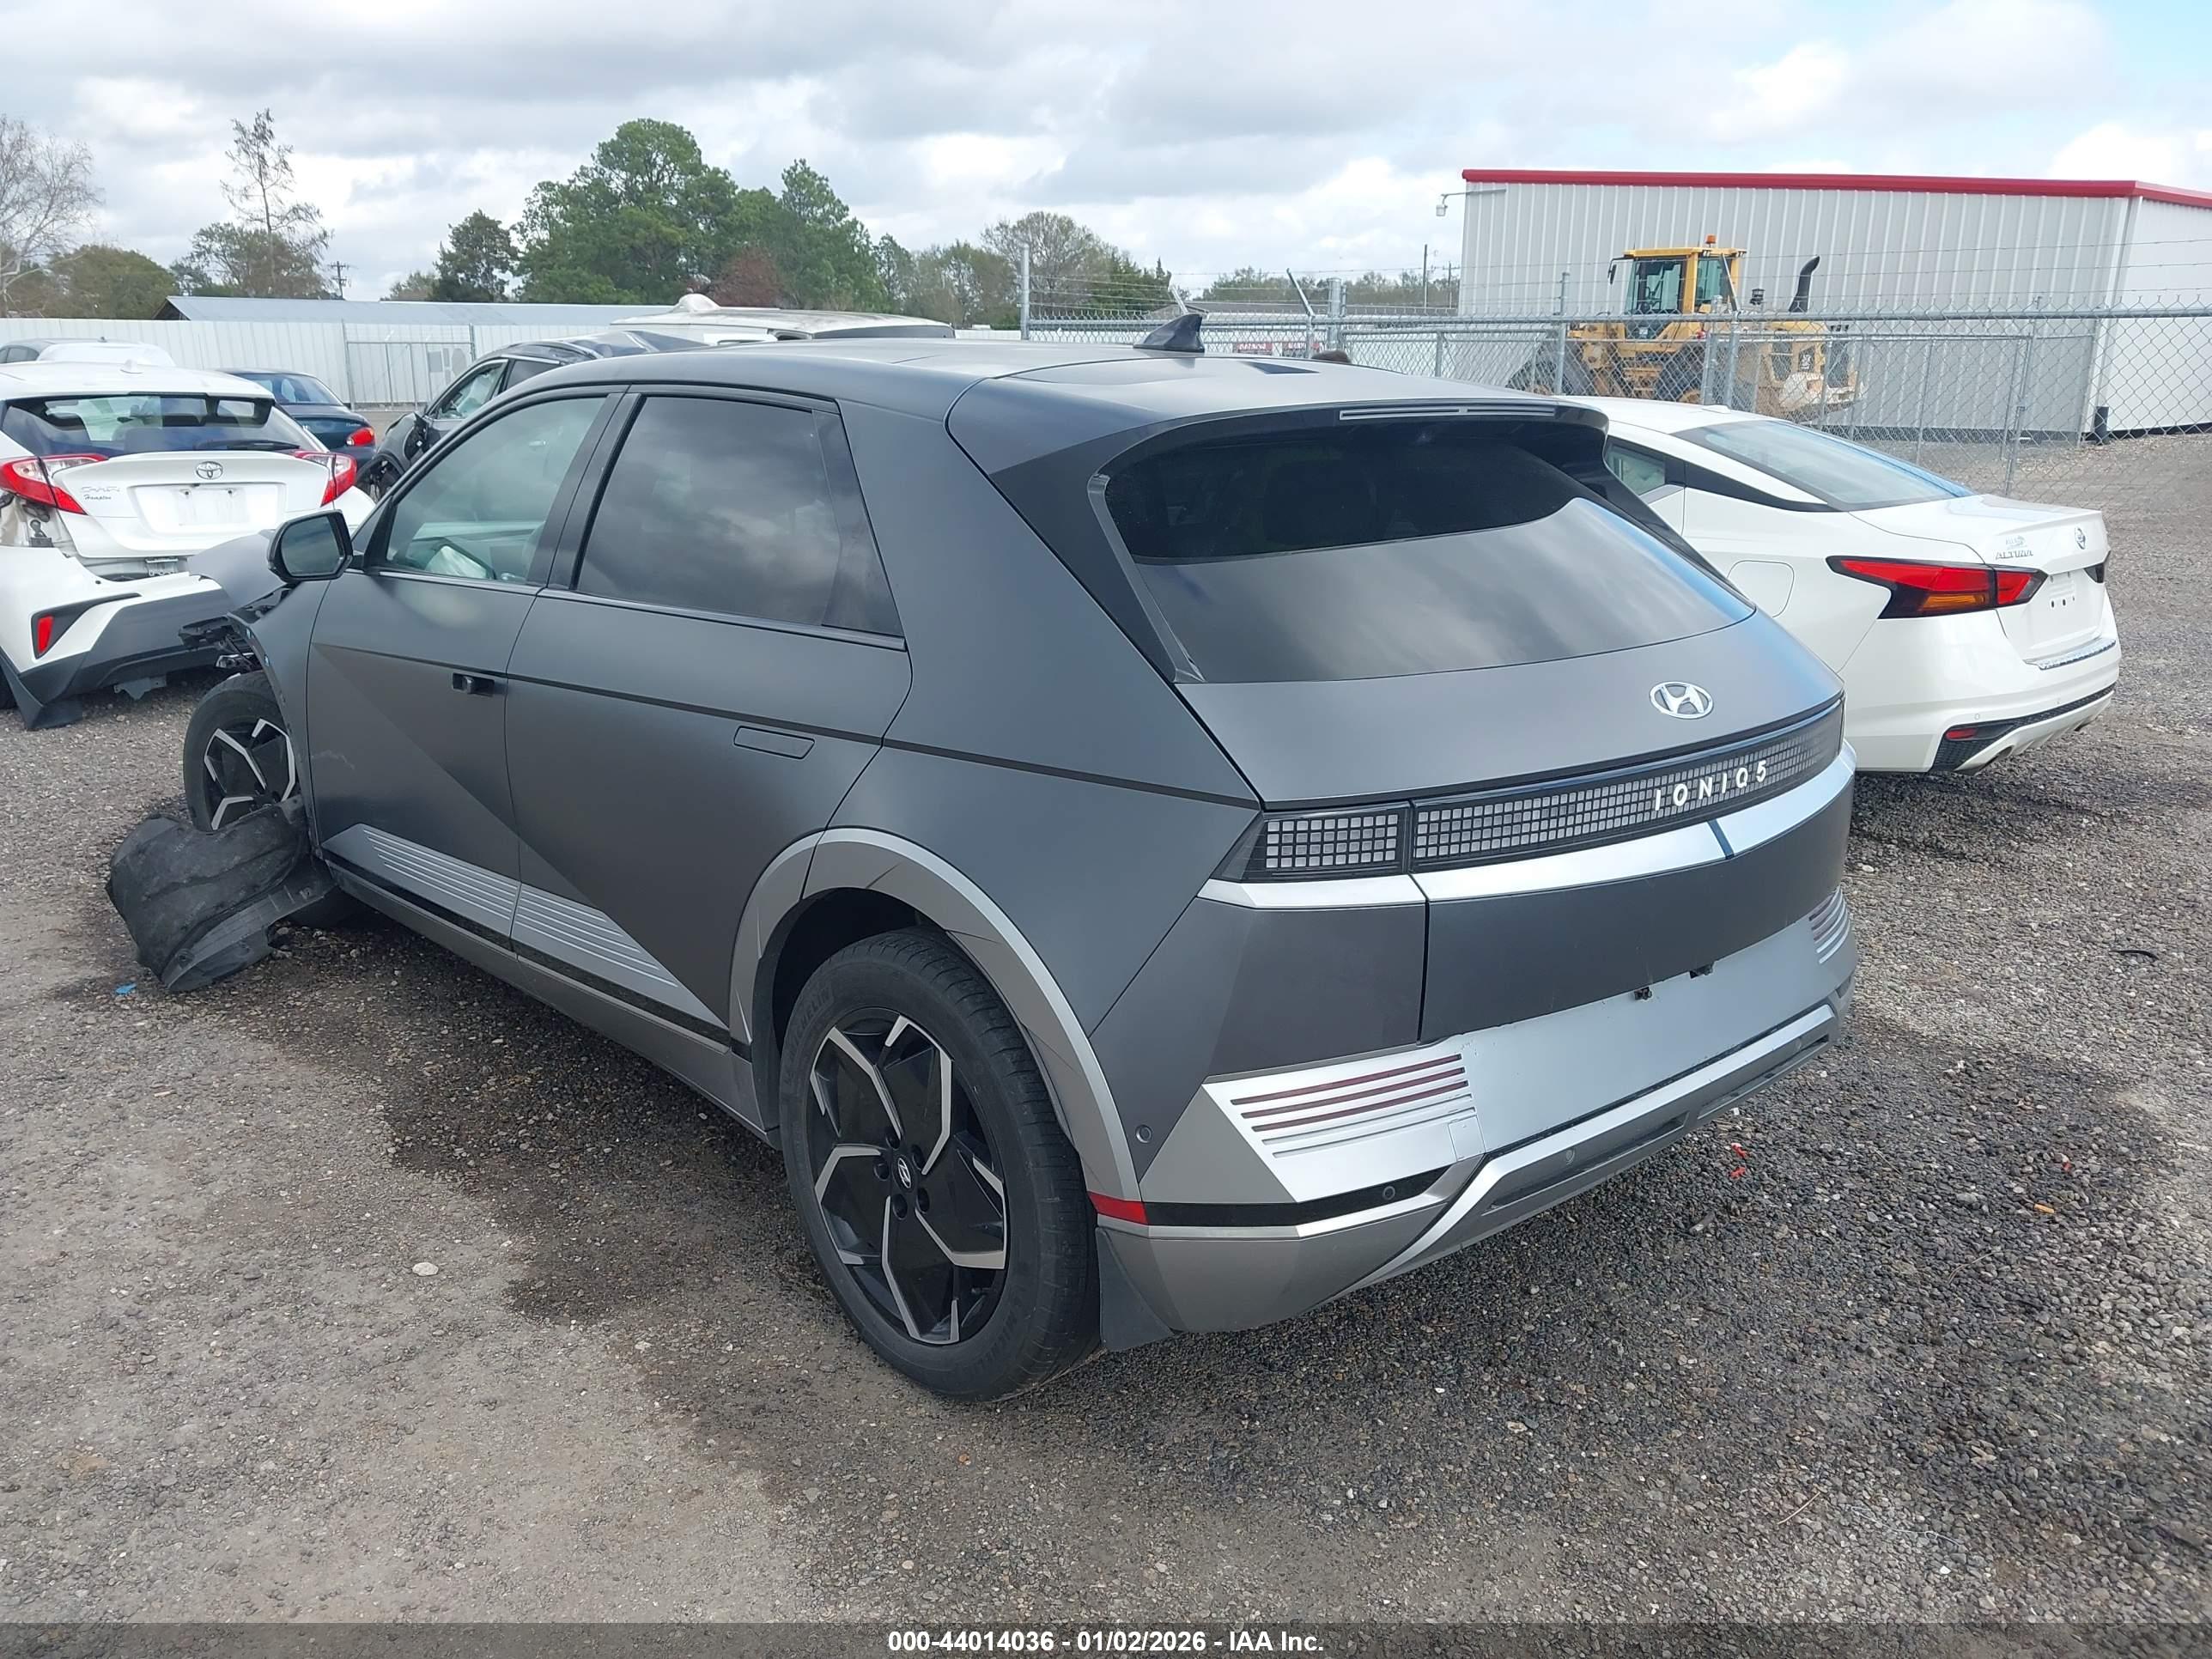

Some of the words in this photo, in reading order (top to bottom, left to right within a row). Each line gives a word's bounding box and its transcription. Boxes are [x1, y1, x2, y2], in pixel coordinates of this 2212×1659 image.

[1995, 550, 2034, 561] ALTIMA
[1655, 767, 1748, 811] IONIQ
[1756, 759, 1767, 782] 5
